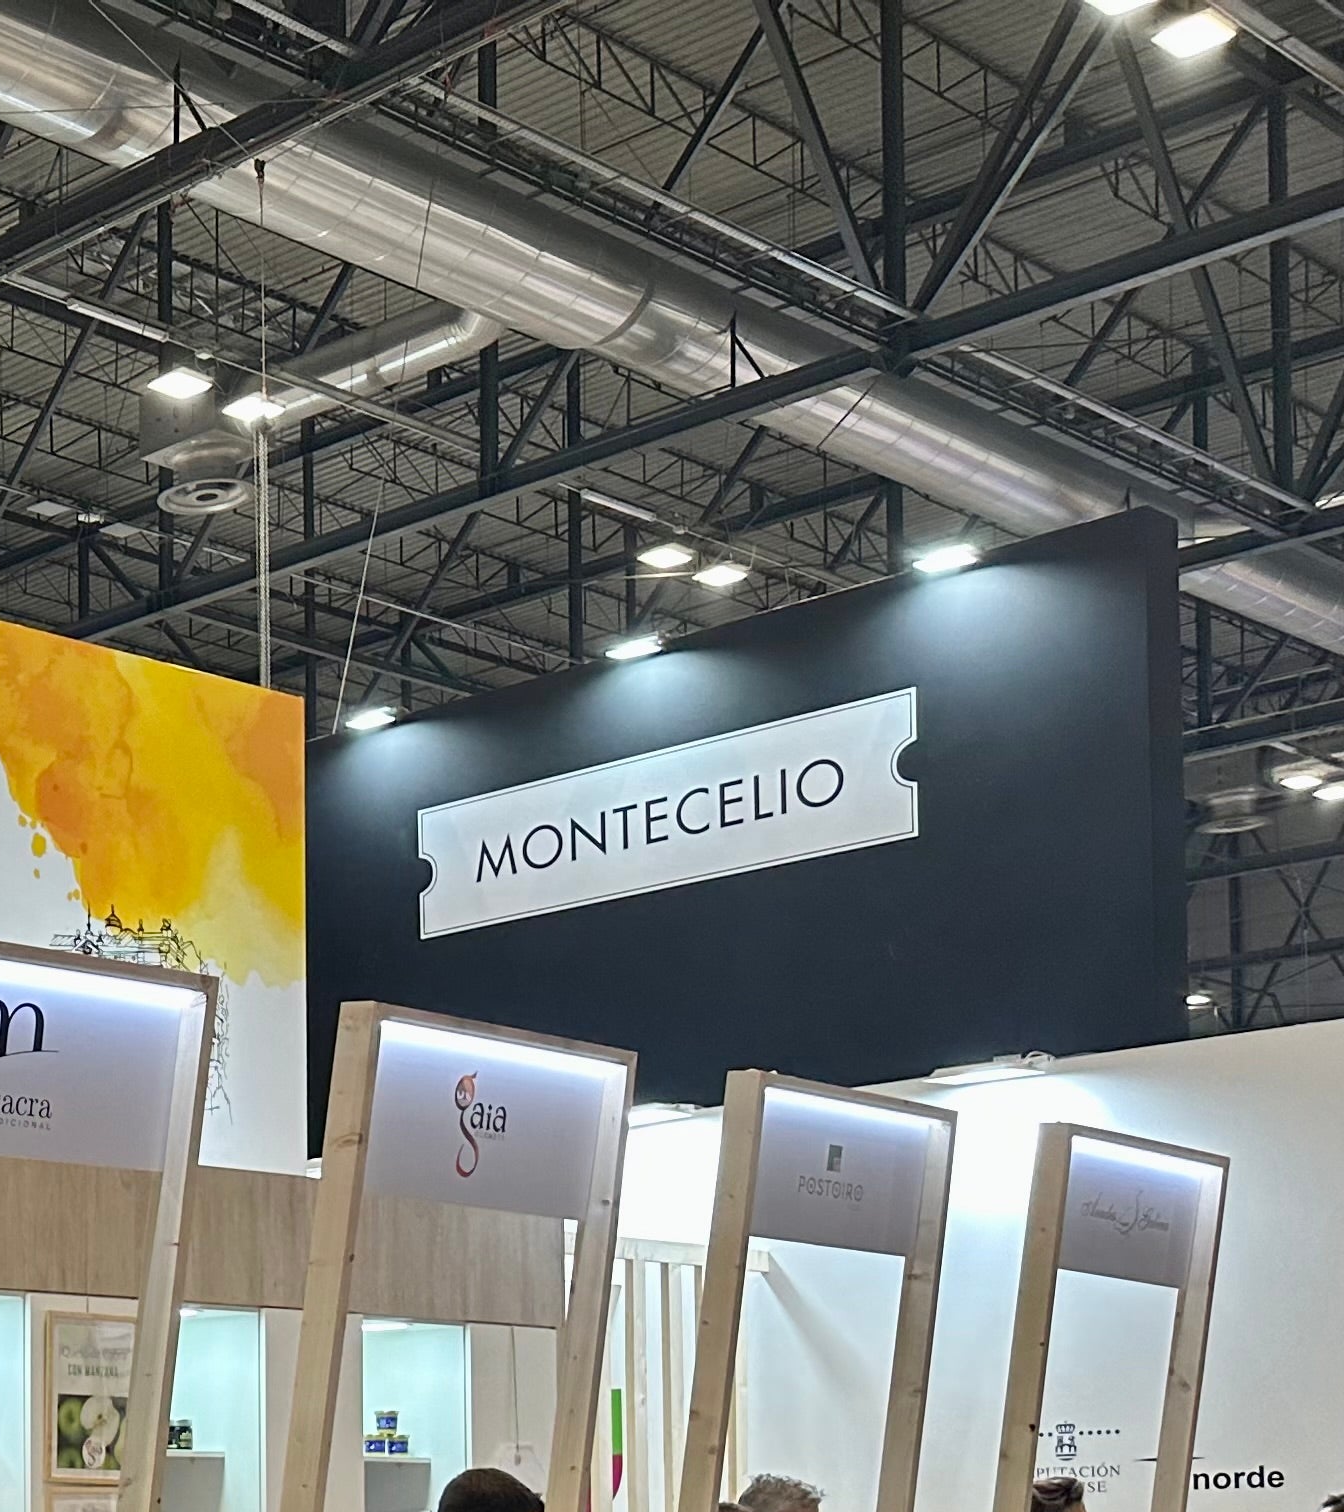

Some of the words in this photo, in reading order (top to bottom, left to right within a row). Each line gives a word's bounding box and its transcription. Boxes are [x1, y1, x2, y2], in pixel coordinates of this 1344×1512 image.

[475, 757, 845, 884] MONTECELIO
[797, 1175, 865, 1203] POSTOIRO
[1192, 1464, 1286, 1490] norde
